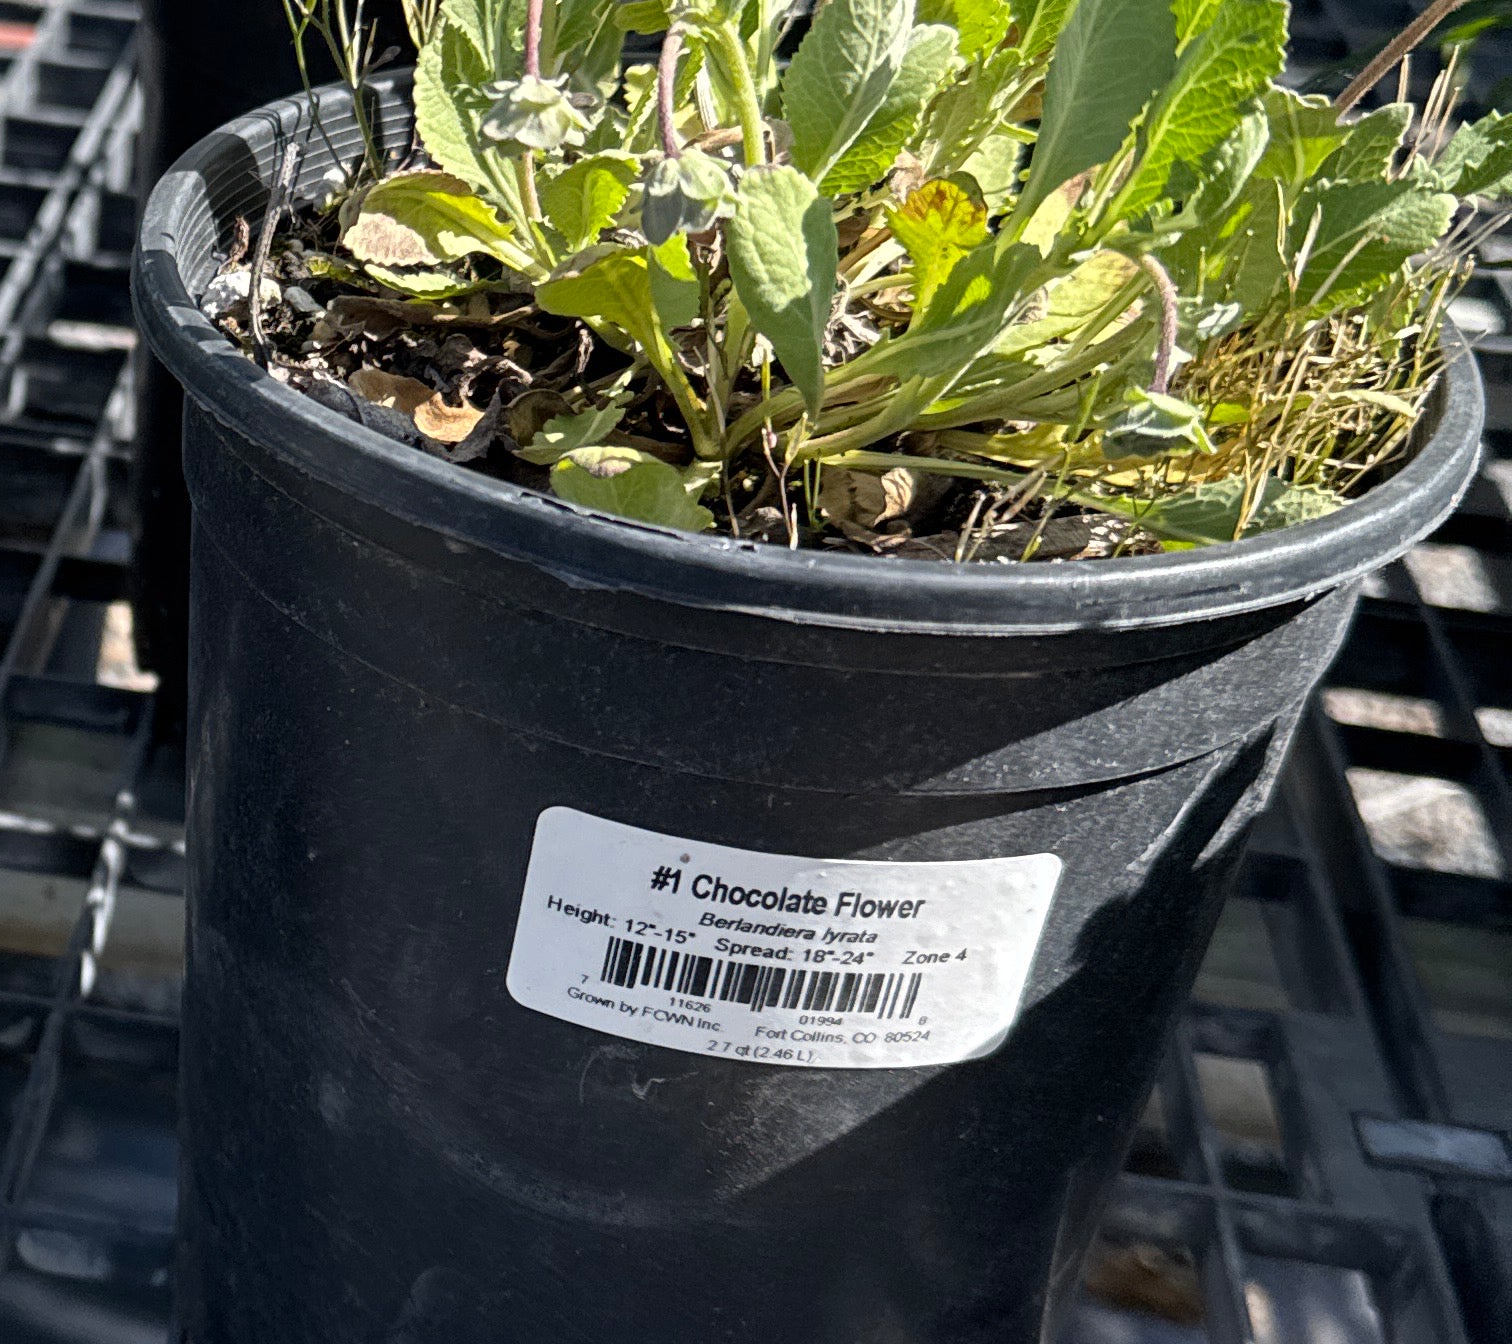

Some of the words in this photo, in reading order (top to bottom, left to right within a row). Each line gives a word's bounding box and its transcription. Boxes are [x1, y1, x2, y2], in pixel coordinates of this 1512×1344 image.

[650, 865, 682, 894] #1
[691, 873, 828, 916] Chocolate
[833, 891, 926, 919] Flower
[547, 894, 617, 929] Height:
[625, 919, 696, 945] 12"-15"
[714, 937, 794, 961] Spread:
[803, 948, 875, 966] 18"-24"
[902, 950, 951, 965] Zone
[955, 948, 968, 962] 4
[698, 912, 816, 941] Berlandiera
[821, 927, 879, 945] lyrata
[567, 986, 615, 1009] Grown
[619, 1001, 639, 1017] by
[641, 1006, 695, 1027] FCWN
[754, 1026, 787, 1040] Fort
[852, 1031, 877, 1044] CO
[884, 1031, 931, 1043] 80524
[581, 974, 590, 985] 7
[669, 996, 713, 1014] 11626
[799, 1015, 843, 1026] 01994
[735, 1044, 750, 1057] qt
[753, 1045, 794, 1061] (246
